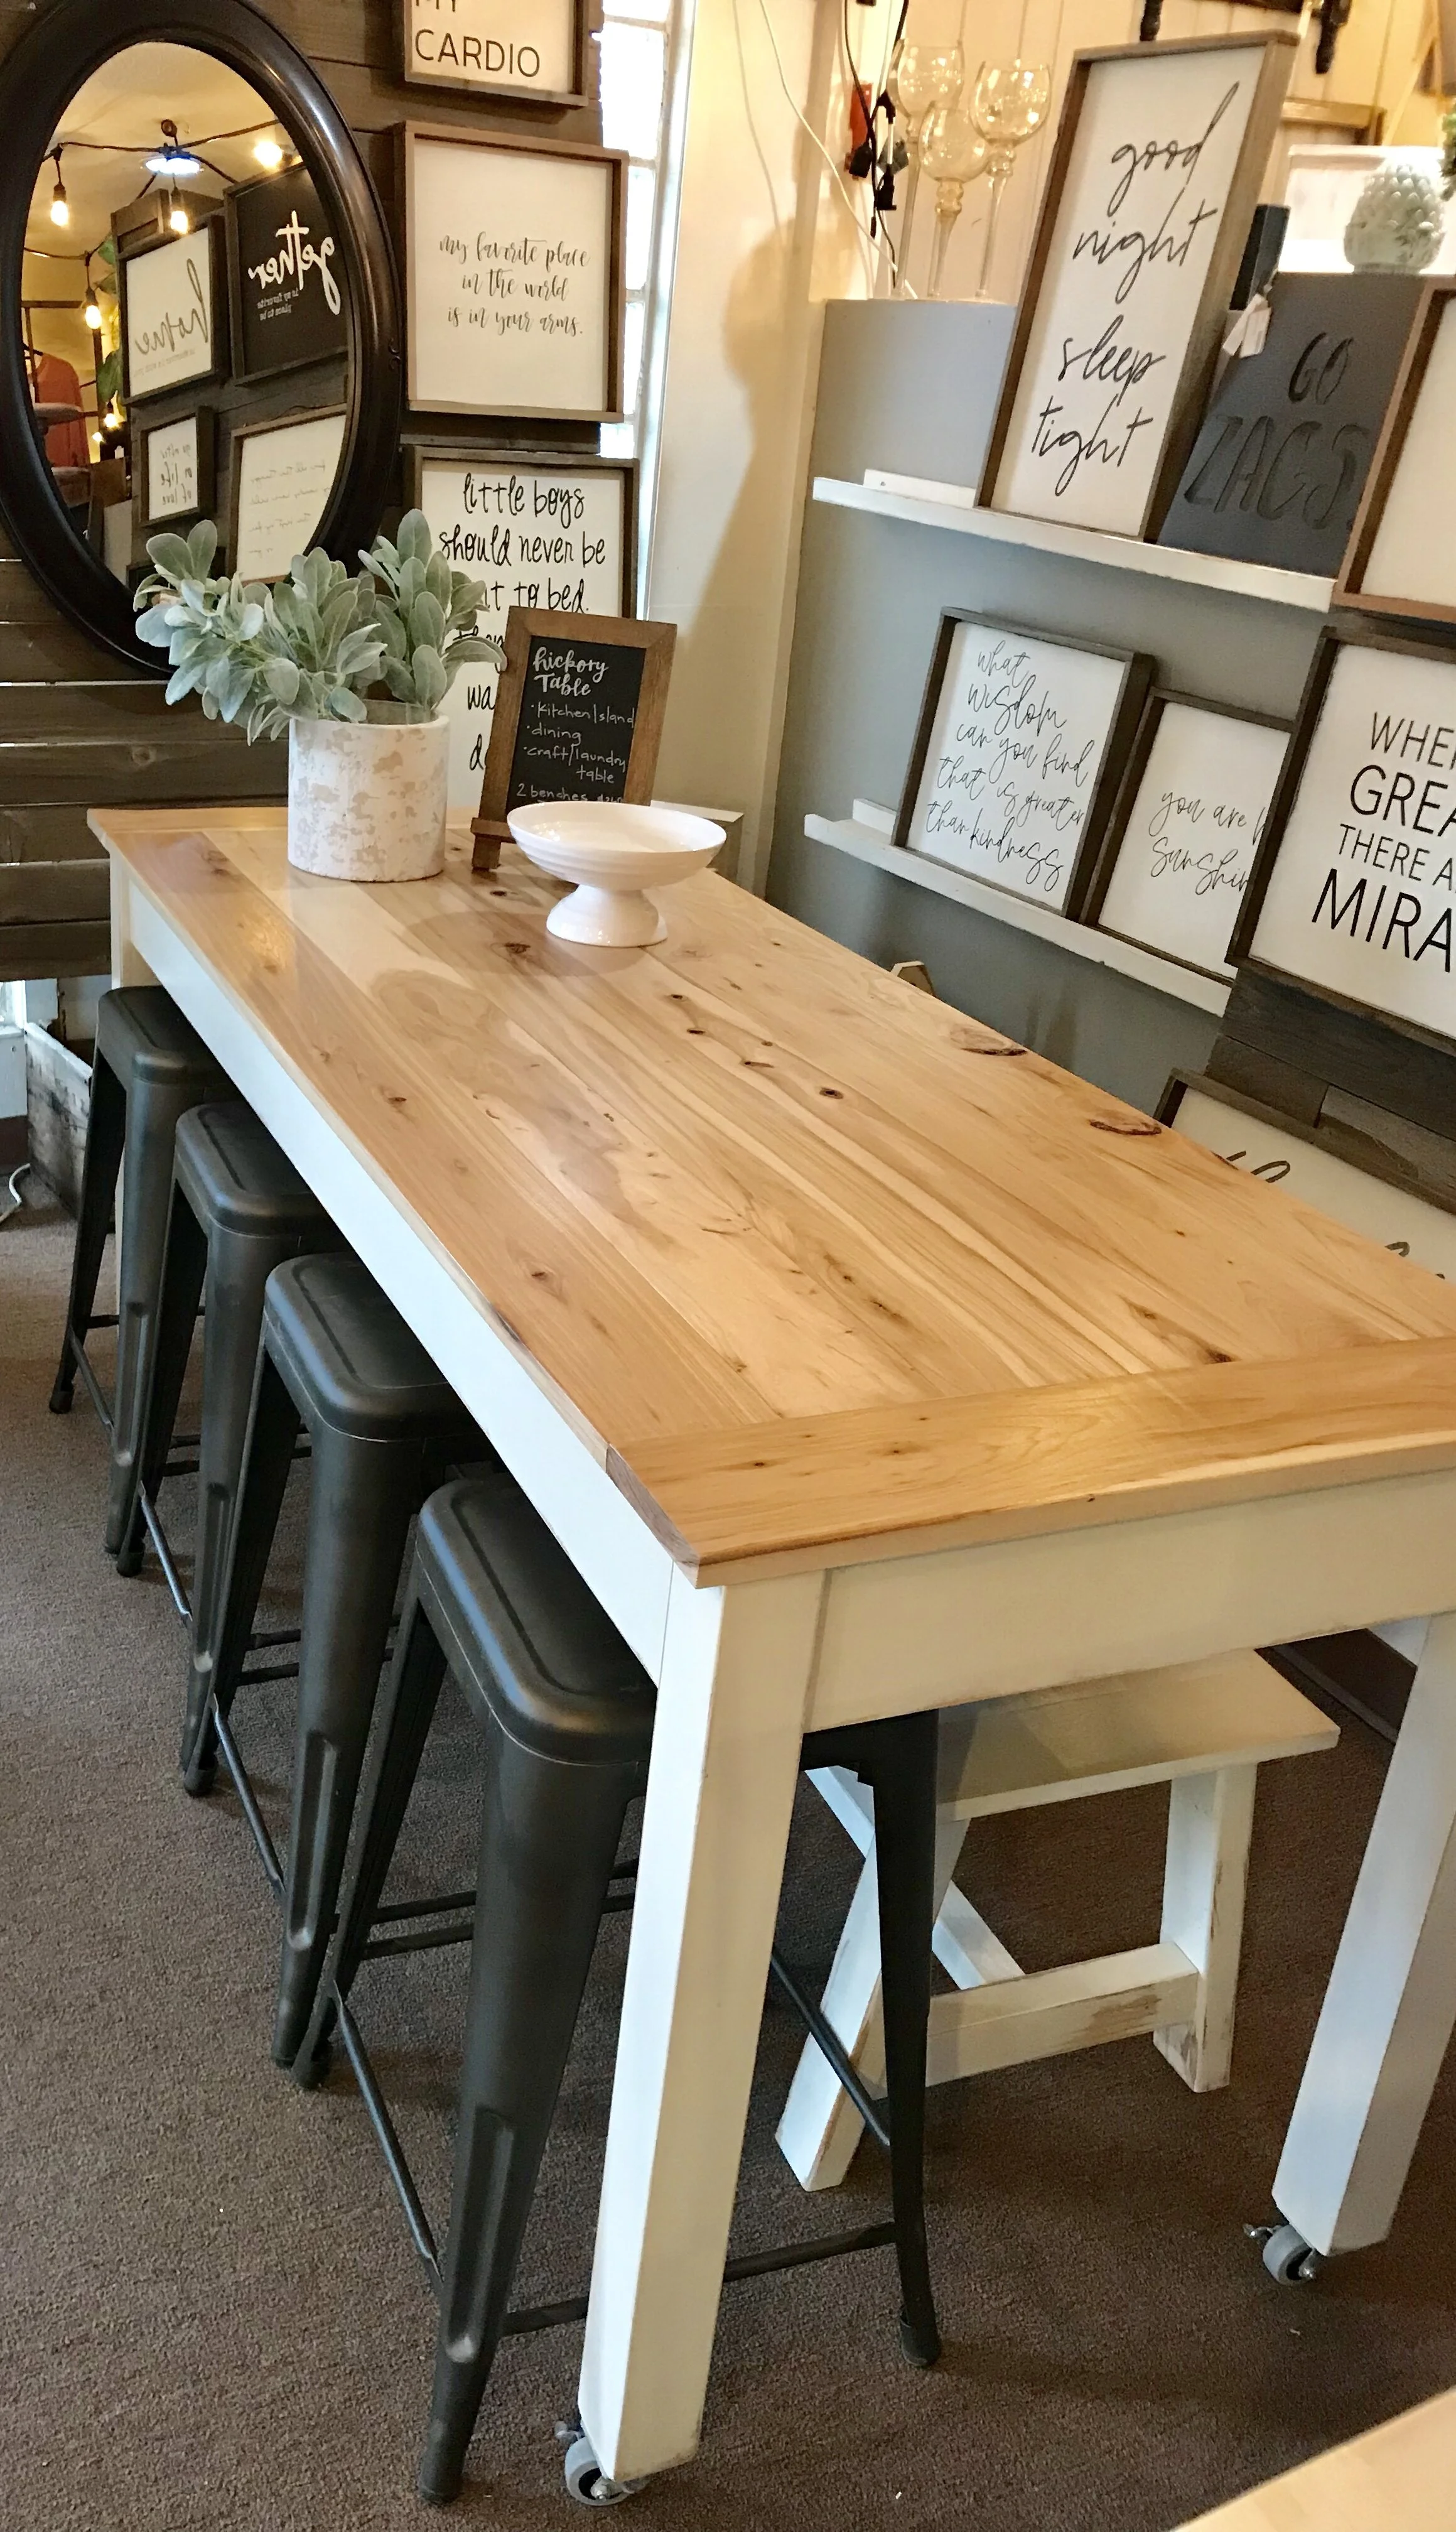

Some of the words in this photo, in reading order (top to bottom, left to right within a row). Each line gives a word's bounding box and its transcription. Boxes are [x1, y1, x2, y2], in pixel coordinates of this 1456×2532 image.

[415, 28, 541, 77] CARDIO
[1106, 80, 1241, 218] good
[439, 235, 468, 264] my
[476, 231, 547, 266] favorite
[546, 241, 591, 273] place
[1072, 187, 1219, 304] night
[462, 273, 482, 295] in
[486, 268, 516, 298] the
[524, 274, 569, 301] world
[448, 306, 463, 327] is
[469, 307, 488, 328] in
[495, 311, 532, 336] your
[1057, 314, 1167, 407] sleep
[1287, 332, 1354, 405] GO
[1032, 393, 1153, 497] tight
[1184, 415, 1370, 530] ZAGS
[463, 472, 525, 516] little
[534, 480, 585, 529] boys
[439, 524, 512, 566] should
[519, 535, 574, 564] never
[583, 531, 605, 568] be
[514, 581, 540, 609] to
[548, 577, 589, 614] bed.
[533, 646, 610, 683] hickory
[534, 673, 592, 697] Table
[978, 640, 1031, 688] what
[968, 674, 1068, 737] wisdom
[531, 722, 582, 746] dining
[956, 723, 993, 748] can
[988, 737, 1039, 785] you
[1042, 732, 1096, 787] find
[1371, 711, 1456, 771] WHE
[516, 782, 526, 797] 2
[531, 784, 588, 801] benches
[576, 764, 615, 784] table
[936, 755, 987, 801] that
[997, 781, 1020, 817] is
[1017, 789, 1085, 831] greater
[1148, 791, 1205, 837] you
[1212, 804, 1248, 828] are
[925, 799, 970, 835] than
[968, 808, 1065, 892] kindness
[1339, 823, 1431, 882] THERE
[1432, 857, 1456, 894] A
